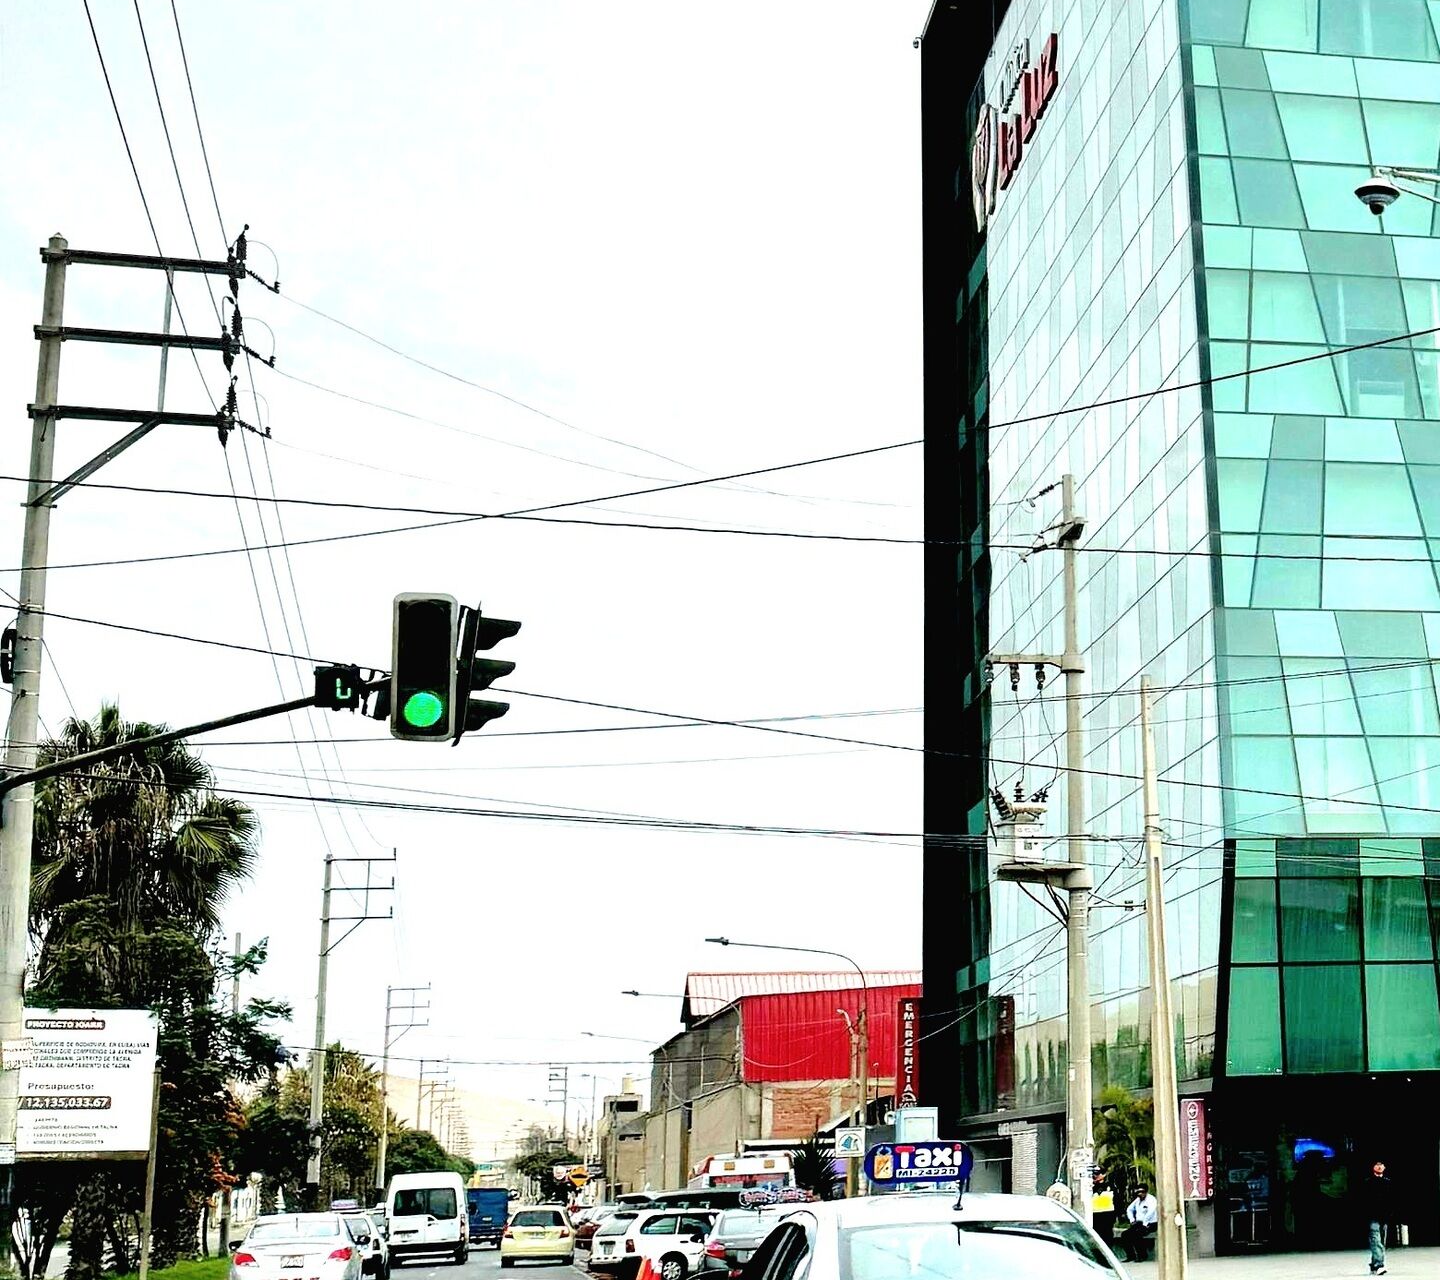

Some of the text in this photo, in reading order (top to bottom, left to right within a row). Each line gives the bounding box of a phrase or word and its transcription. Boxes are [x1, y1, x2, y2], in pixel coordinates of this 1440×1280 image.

[27, 1020, 73, 1029] PROYECTO
[904, 1002, 915, 1092] EMERGENCIA
[28, 1082, 94, 1091] Presupuesto:
[895, 1144, 962, 1169] Taxi
